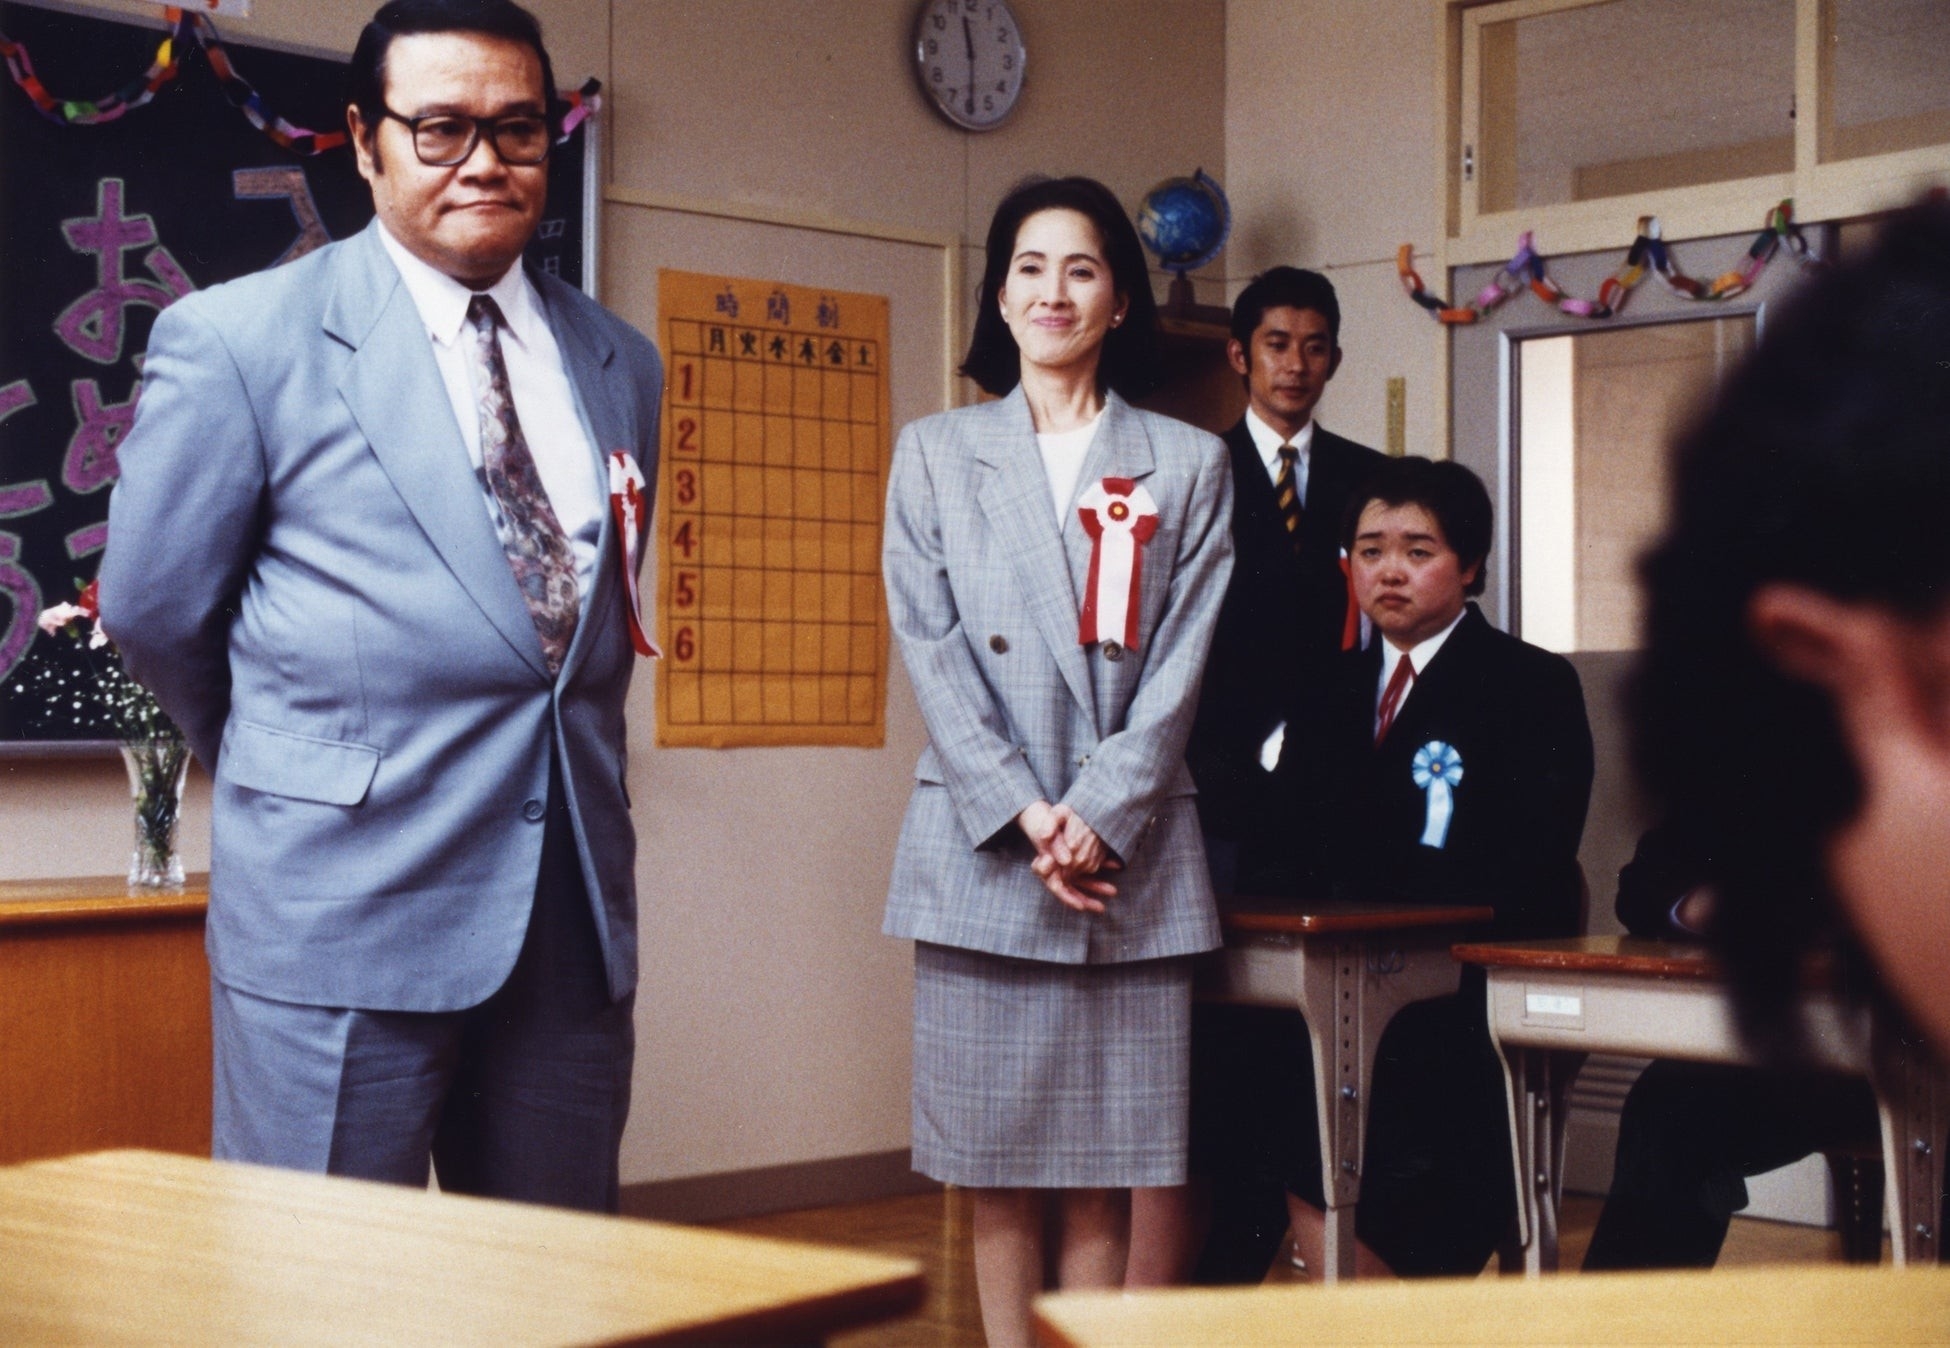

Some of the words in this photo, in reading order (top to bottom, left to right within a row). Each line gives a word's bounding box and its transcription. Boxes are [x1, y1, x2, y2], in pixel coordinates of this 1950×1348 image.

[998, 28, 1008, 43] 2
[928, 39, 938, 55] 9
[1003, 55, 1012, 70] 3
[933, 66, 943, 82] 8
[995, 80, 1006, 93] 4
[948, 88, 958, 102] 7
[984, 95, 994, 111] 5
[680, 364, 694, 400] 1
[677, 418, 697, 450] 2
[676, 469, 696, 504] 3
[674, 521, 697, 558] 4
[675, 573, 696, 608] 5
[675, 627, 694, 662] 6
